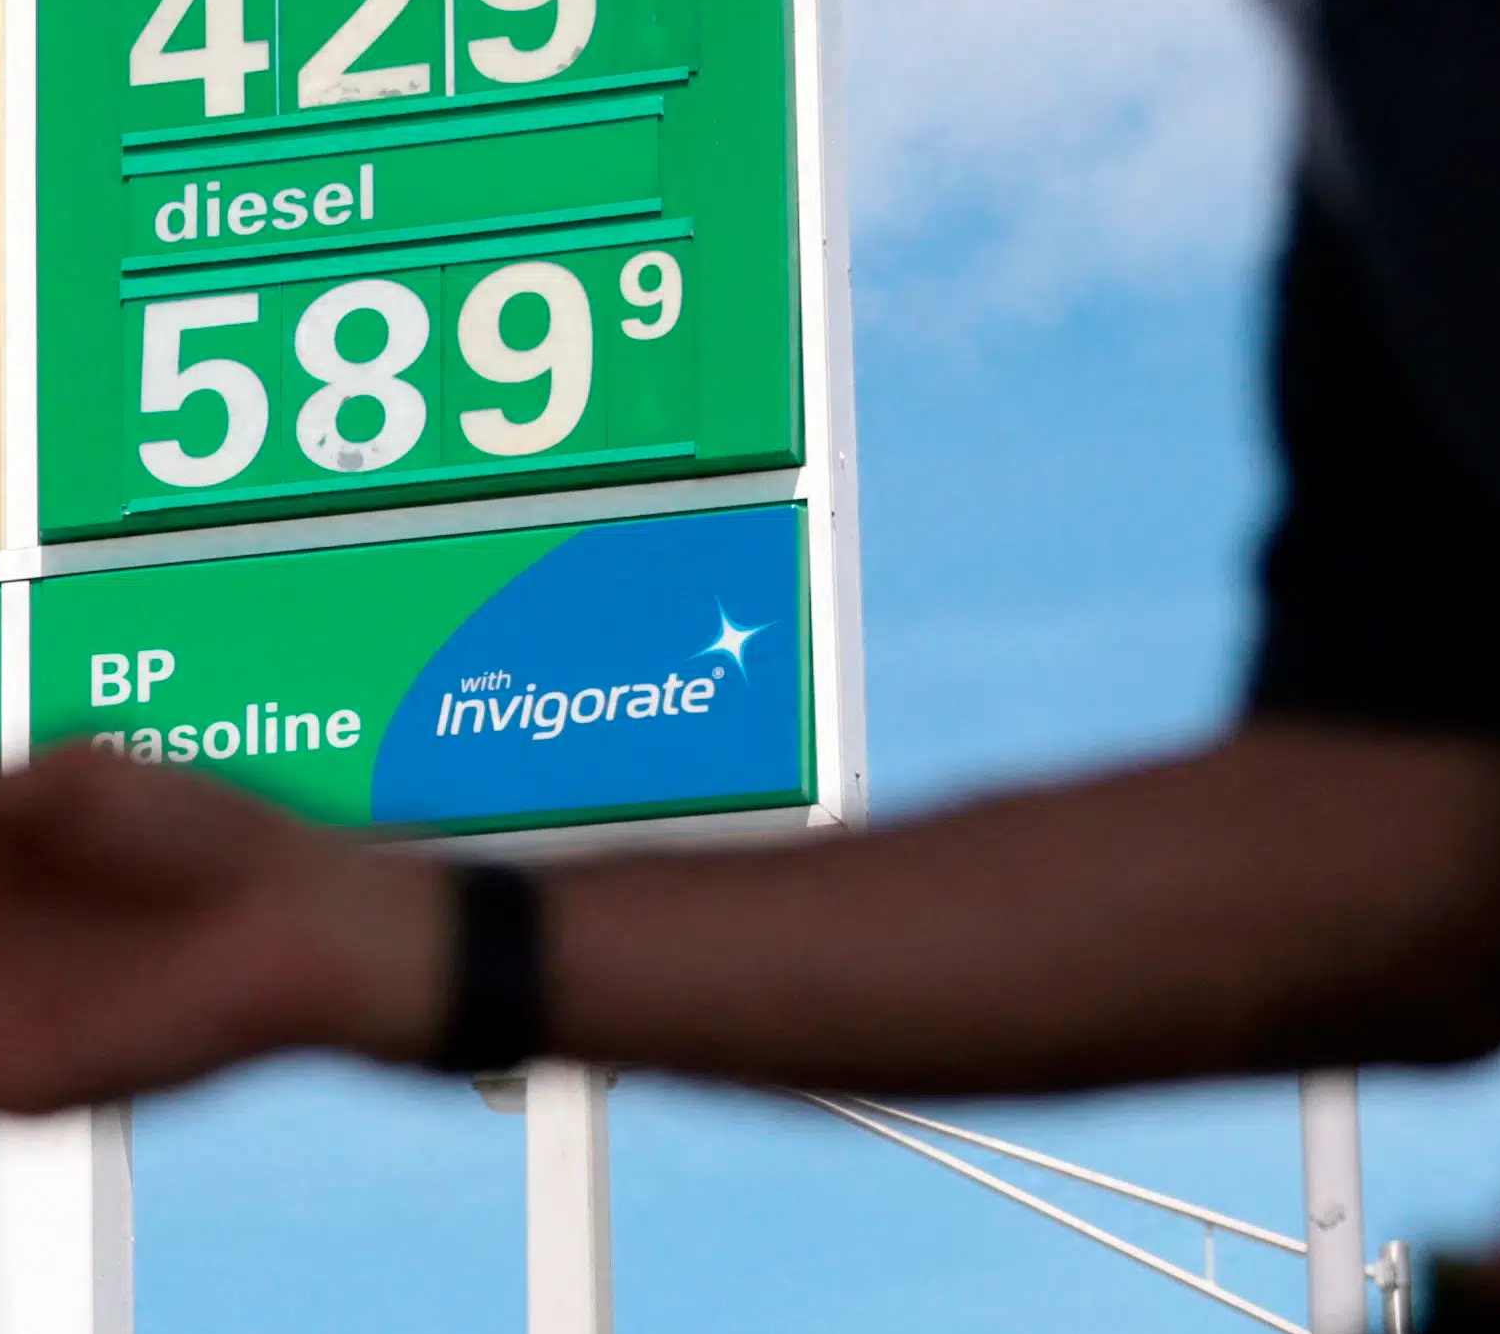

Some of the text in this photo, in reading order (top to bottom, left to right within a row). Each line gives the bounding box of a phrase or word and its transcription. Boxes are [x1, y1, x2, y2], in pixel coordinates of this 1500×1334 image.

[154, 163, 376, 243] diesel
[90, 649, 175, 707] BP
[460, 670, 512, 693] with
